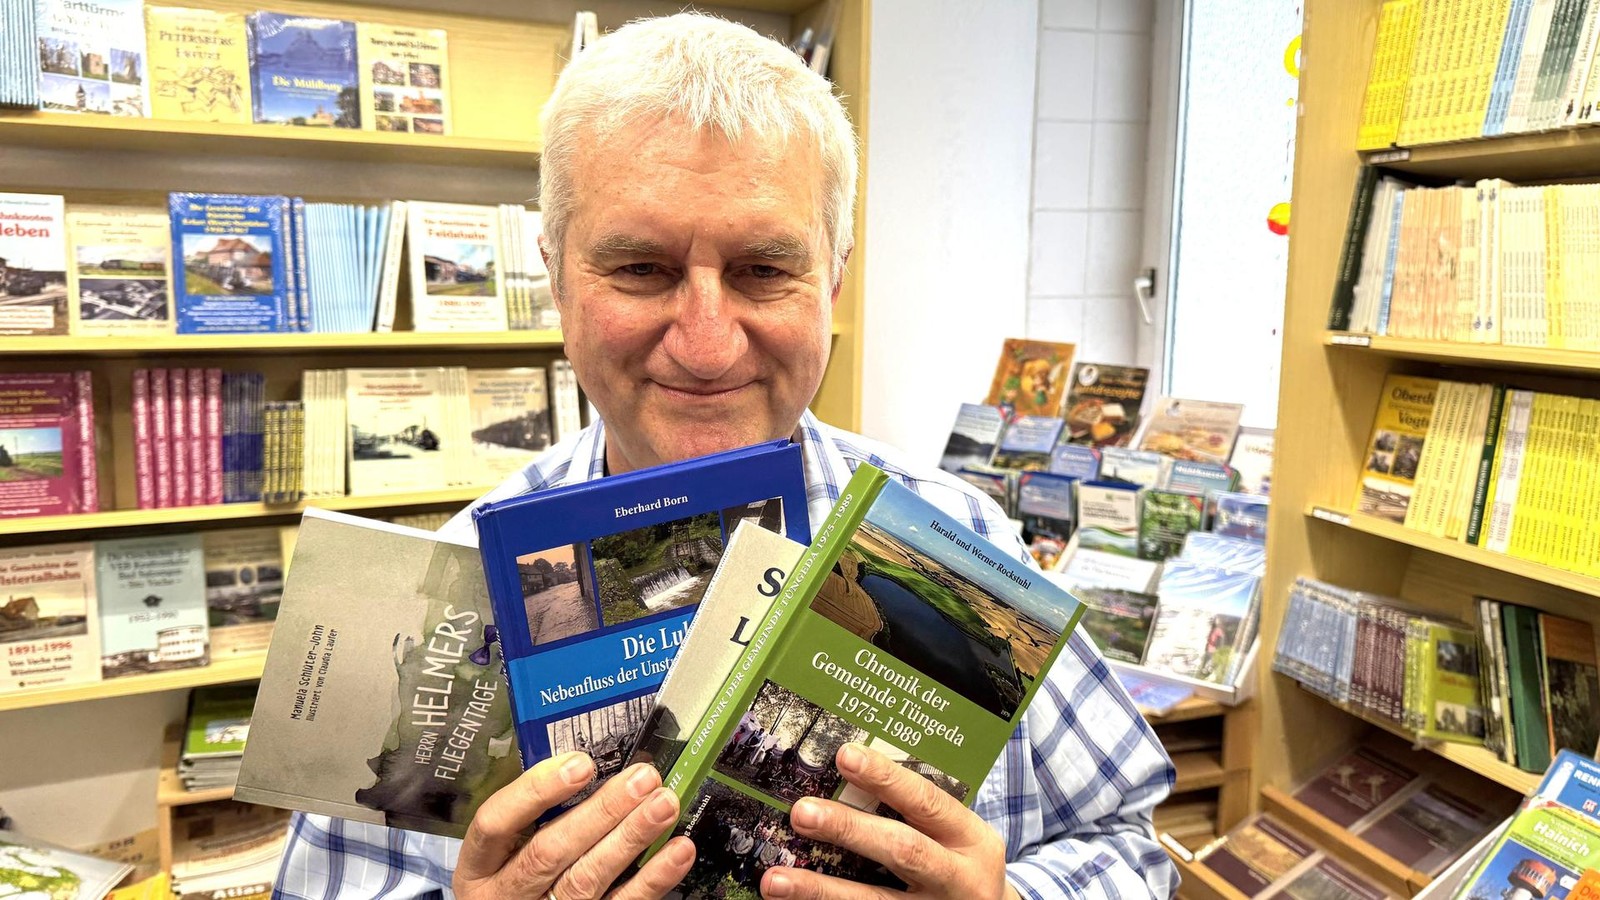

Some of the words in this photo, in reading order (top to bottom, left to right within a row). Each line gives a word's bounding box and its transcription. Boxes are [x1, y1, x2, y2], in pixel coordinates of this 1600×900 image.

[614, 499, 661, 518] Eberhard
[664, 494, 689, 508] Born
[930, 520, 957, 542] Harald
[956, 537, 973, 552] und
[972, 546, 999, 568] Werner
[996, 563, 1033, 590] Rockstuhl
[690, 697, 729, 757] CHRONIK
[725, 671, 745, 698] DER
[742, 607, 783, 672] GEMEINDE
[780, 552, 819, 608] TÜNGEDA
[815, 493, 854, 551] 1975–1989
[318, 652, 332, 674] Claudia
[411, 604, 480, 727] HELMERS
[621, 634, 656, 660] Die
[290, 688, 308, 720] Manuela
[299, 624, 325, 686] Schlüter-John
[316, 676, 325, 688] von
[540, 674, 615, 706] Nebenfluss
[617, 667, 638, 684] der
[854, 649, 922, 697] Chronik
[921, 687, 950, 712] der
[306, 690, 322, 722] Illustriert
[812, 651, 897, 709] Gemeinde
[898, 697, 965, 748] Tüngeda
[836, 691, 922, 747] 1975–1989
[414, 730, 440, 765] HERRN
[434, 678, 498, 781] FLIEGENTAGE
[686, 794, 712, 833] Rockstuhl
[1533, 820, 1590, 857] Hainich
[212, 883, 266, 899] Atlas
